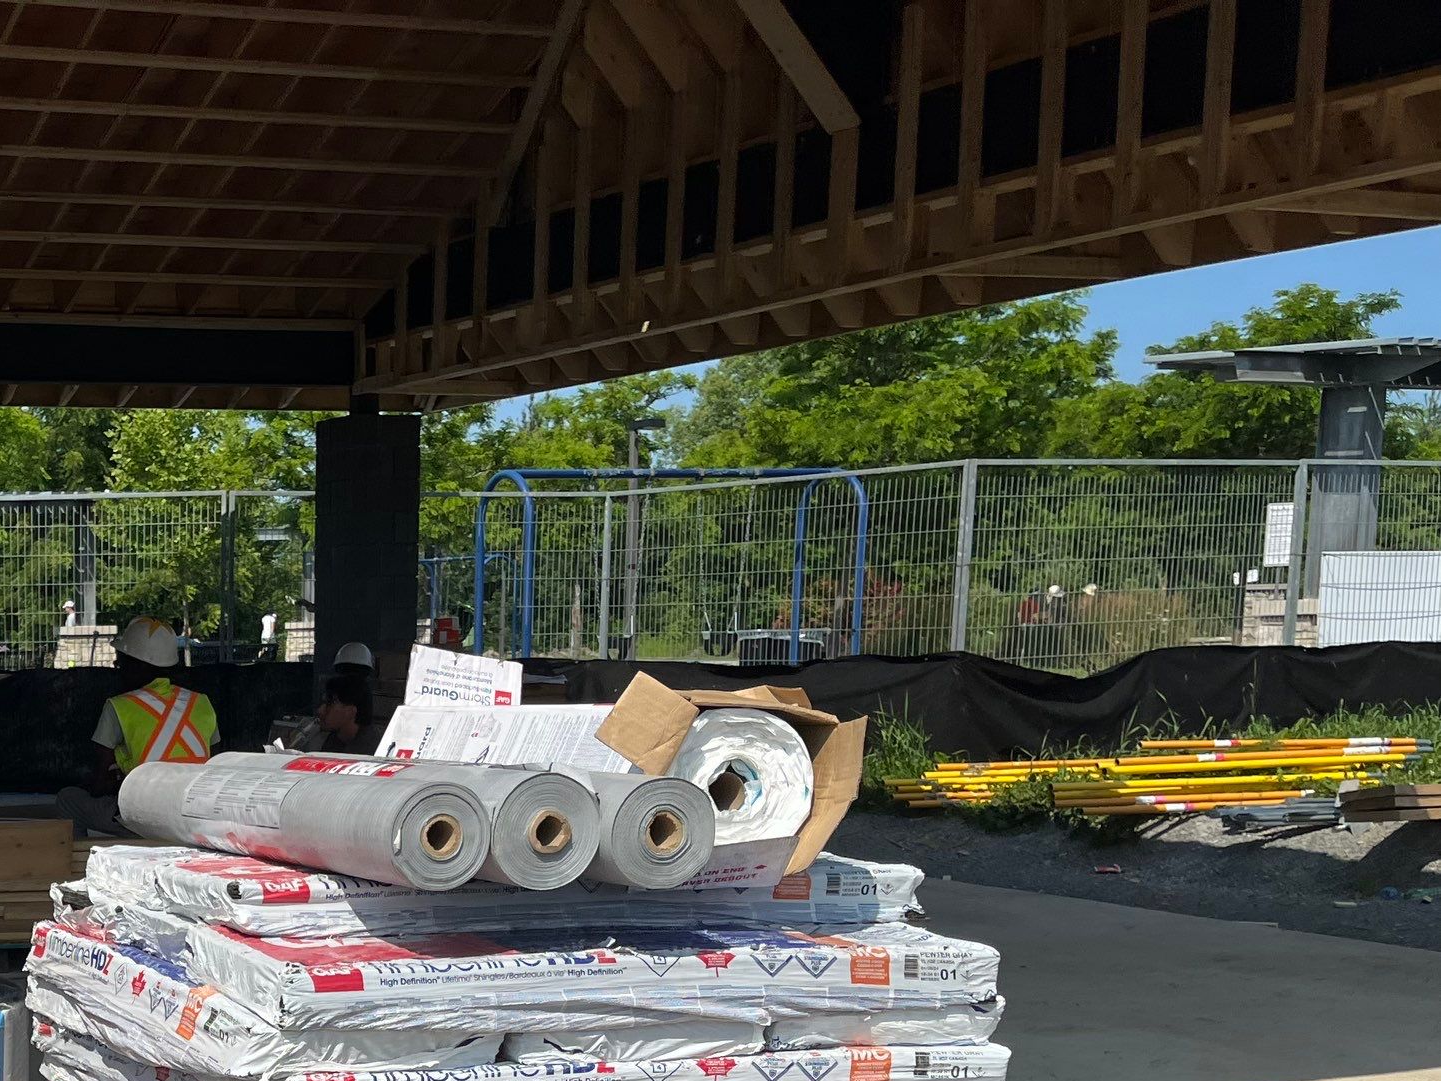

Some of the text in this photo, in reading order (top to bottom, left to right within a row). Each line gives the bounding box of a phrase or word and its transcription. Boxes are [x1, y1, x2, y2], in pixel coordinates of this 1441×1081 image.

[421, 686, 491, 706] StormGuard
[861, 883, 878, 896] 01
[380, 977, 398, 986] High
[400, 976, 438, 985] Definition
[567, 969, 585, 978] High
[587, 967, 623, 975] Definition
[940, 969, 957, 981] 01
[950, 1066, 969, 1079] 01
